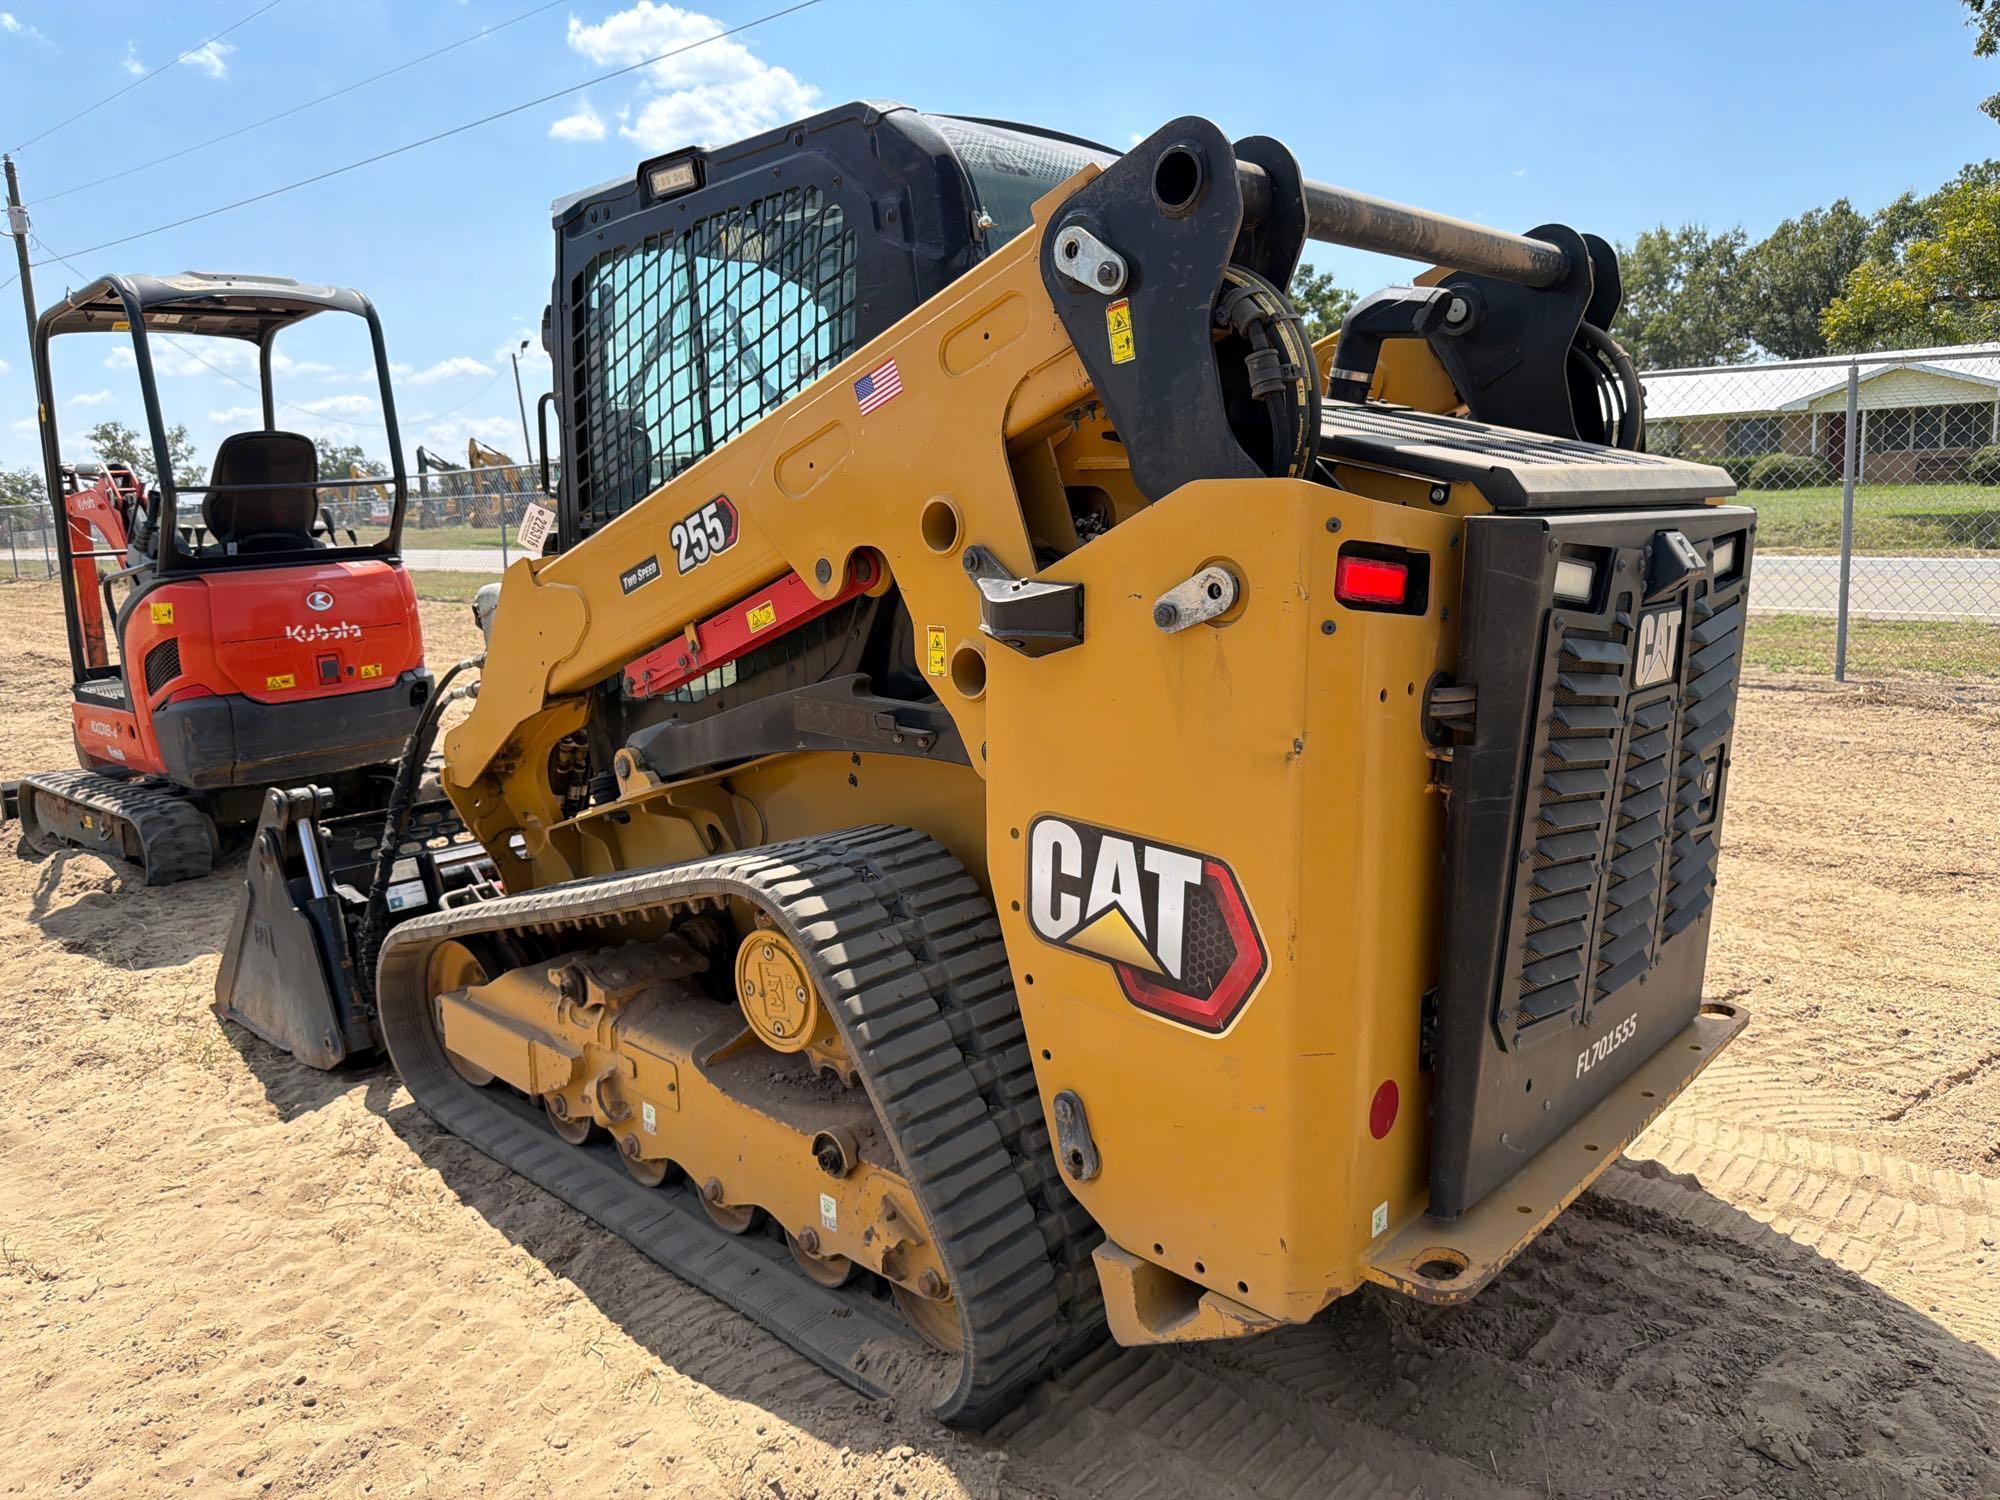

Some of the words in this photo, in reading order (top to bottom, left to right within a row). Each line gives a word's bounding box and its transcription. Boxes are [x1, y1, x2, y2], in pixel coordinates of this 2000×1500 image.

[527, 516, 548, 548] 225316
[671, 502, 726, 572] 255
[285, 621, 362, 642] Kubota
[1635, 609, 1682, 688] CAT
[1031, 819, 1203, 980] CAT
[1575, 1012, 1638, 1079] FL701555
